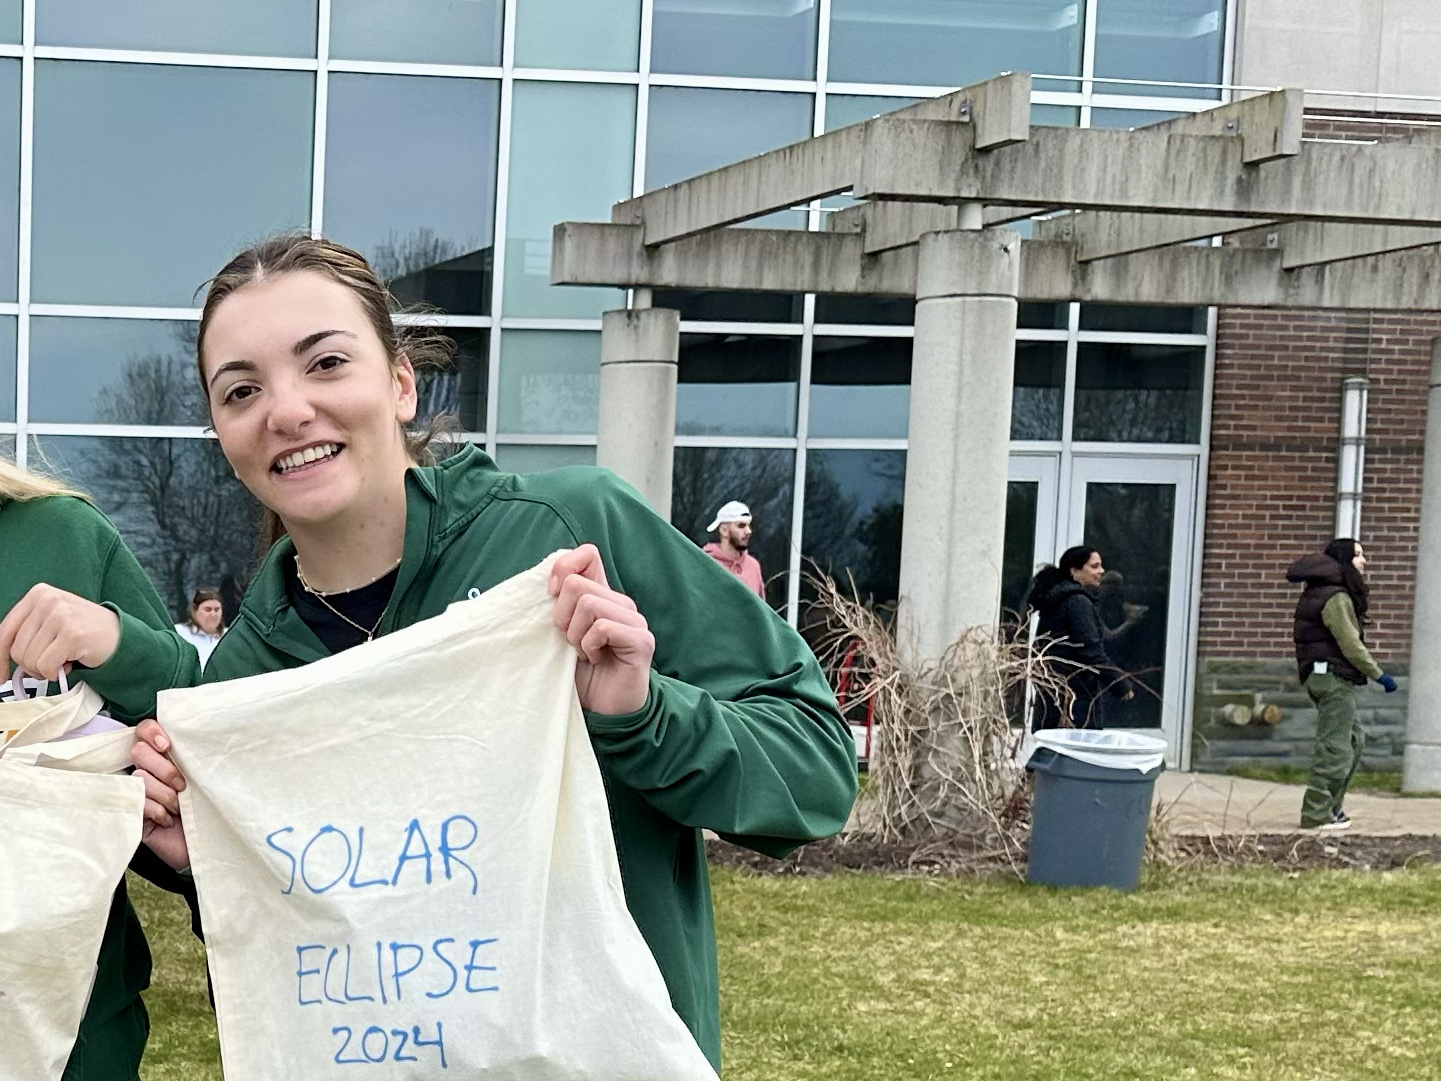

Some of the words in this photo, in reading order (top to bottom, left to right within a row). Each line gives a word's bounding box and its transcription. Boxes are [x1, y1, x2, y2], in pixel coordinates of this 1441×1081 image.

[265, 814, 478, 896] SOLAR
[295, 937, 500, 1006] ECLIPSE
[331, 1020, 448, 1070] 2024
